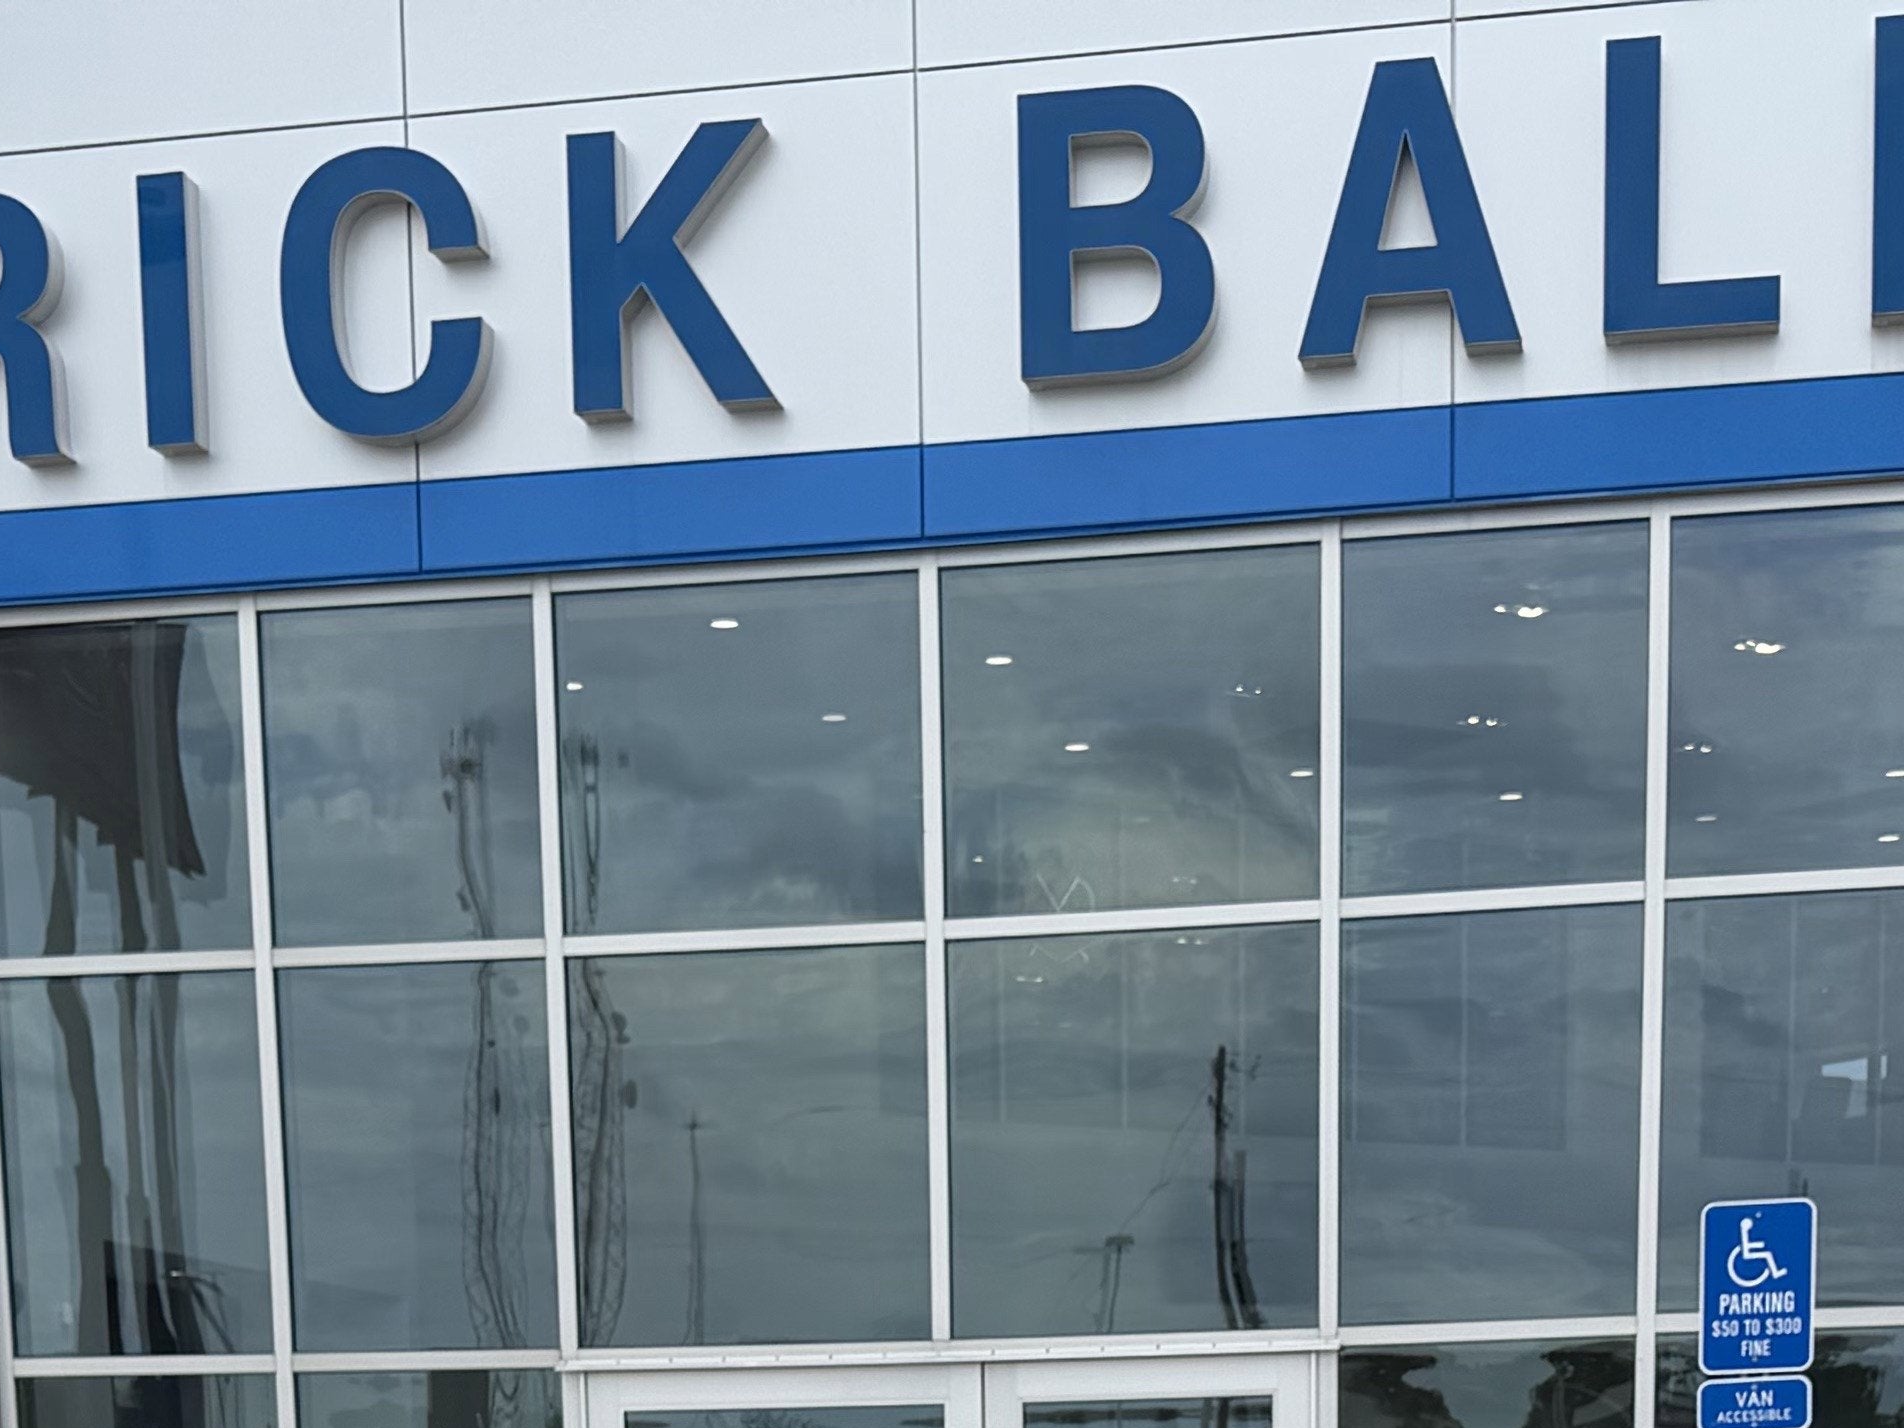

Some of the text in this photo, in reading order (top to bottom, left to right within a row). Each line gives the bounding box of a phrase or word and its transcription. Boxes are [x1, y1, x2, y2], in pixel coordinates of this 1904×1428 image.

[1719, 1290, 1795, 1316] PARKING
[1712, 1317, 1802, 1338] $50 TO $300
[1740, 1338, 1771, 1357] FINE
[1735, 1389, 1773, 1408] VAN
[1717, 1407, 1792, 1424] ACCESSIBLE
